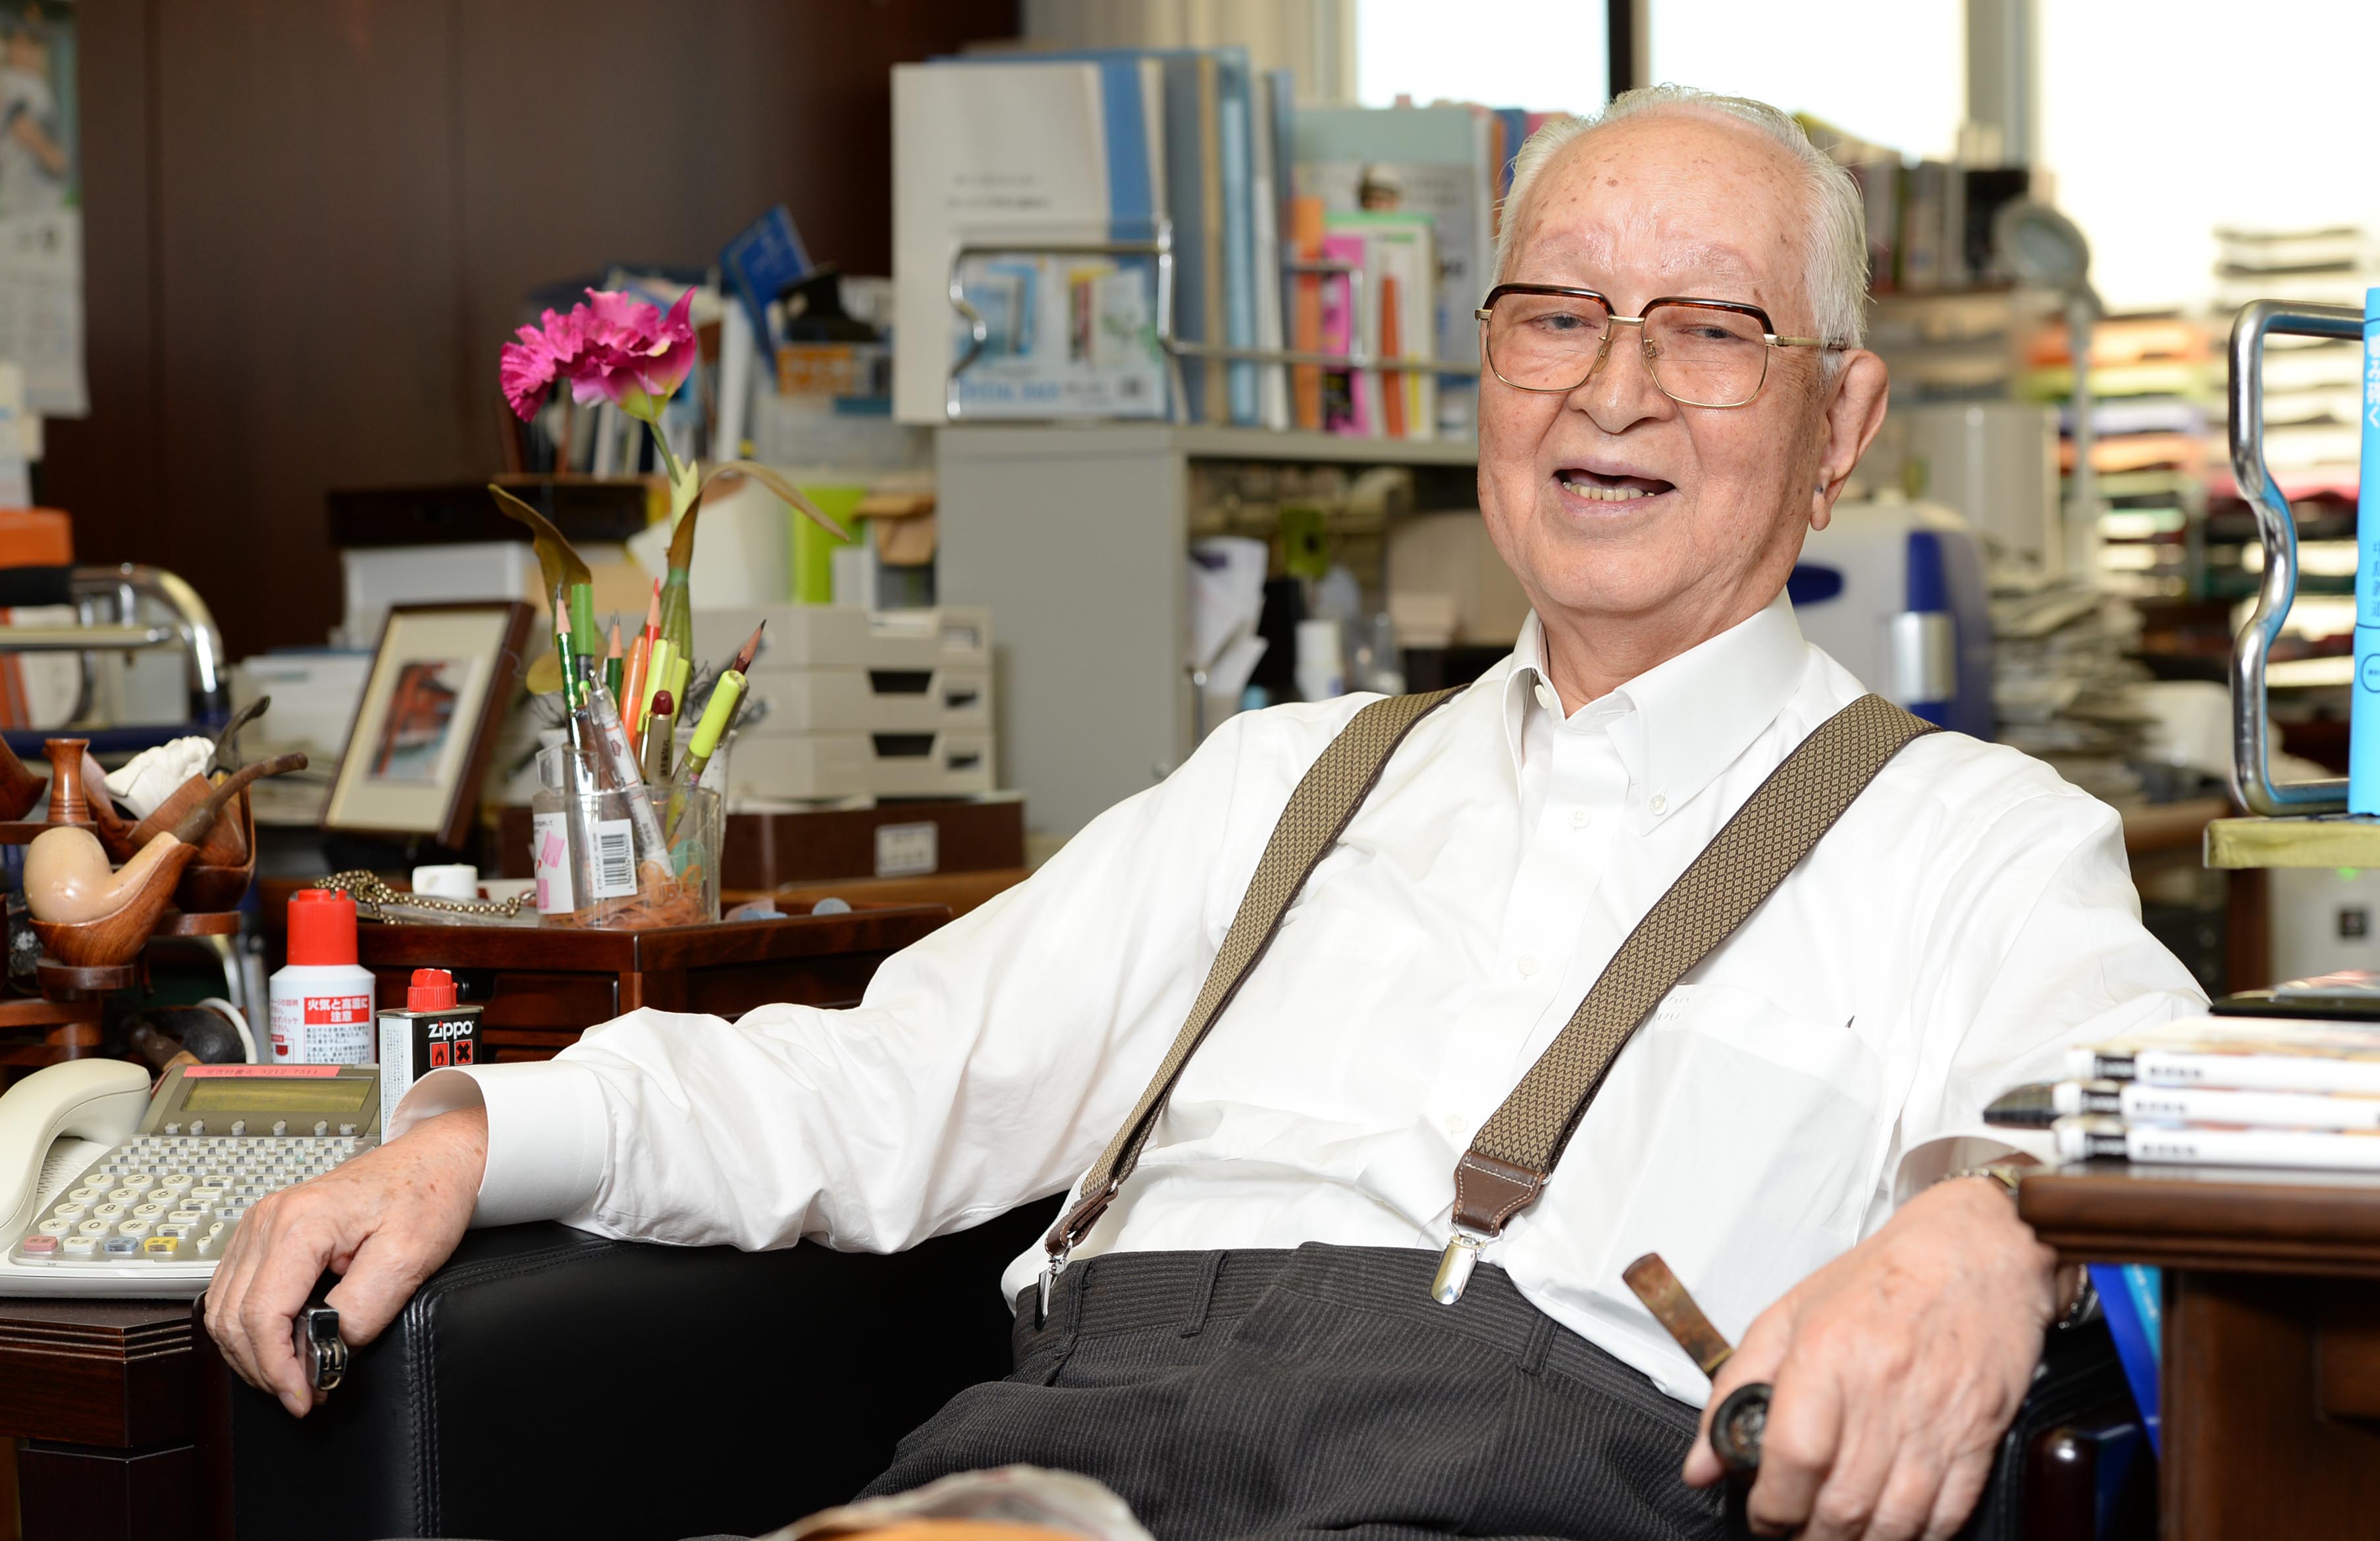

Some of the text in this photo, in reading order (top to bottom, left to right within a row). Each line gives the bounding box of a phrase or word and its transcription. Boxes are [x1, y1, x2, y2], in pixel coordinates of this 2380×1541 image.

[307, 998, 369, 1011] 火気と高温に
[331, 1011, 353, 1022] 注意
